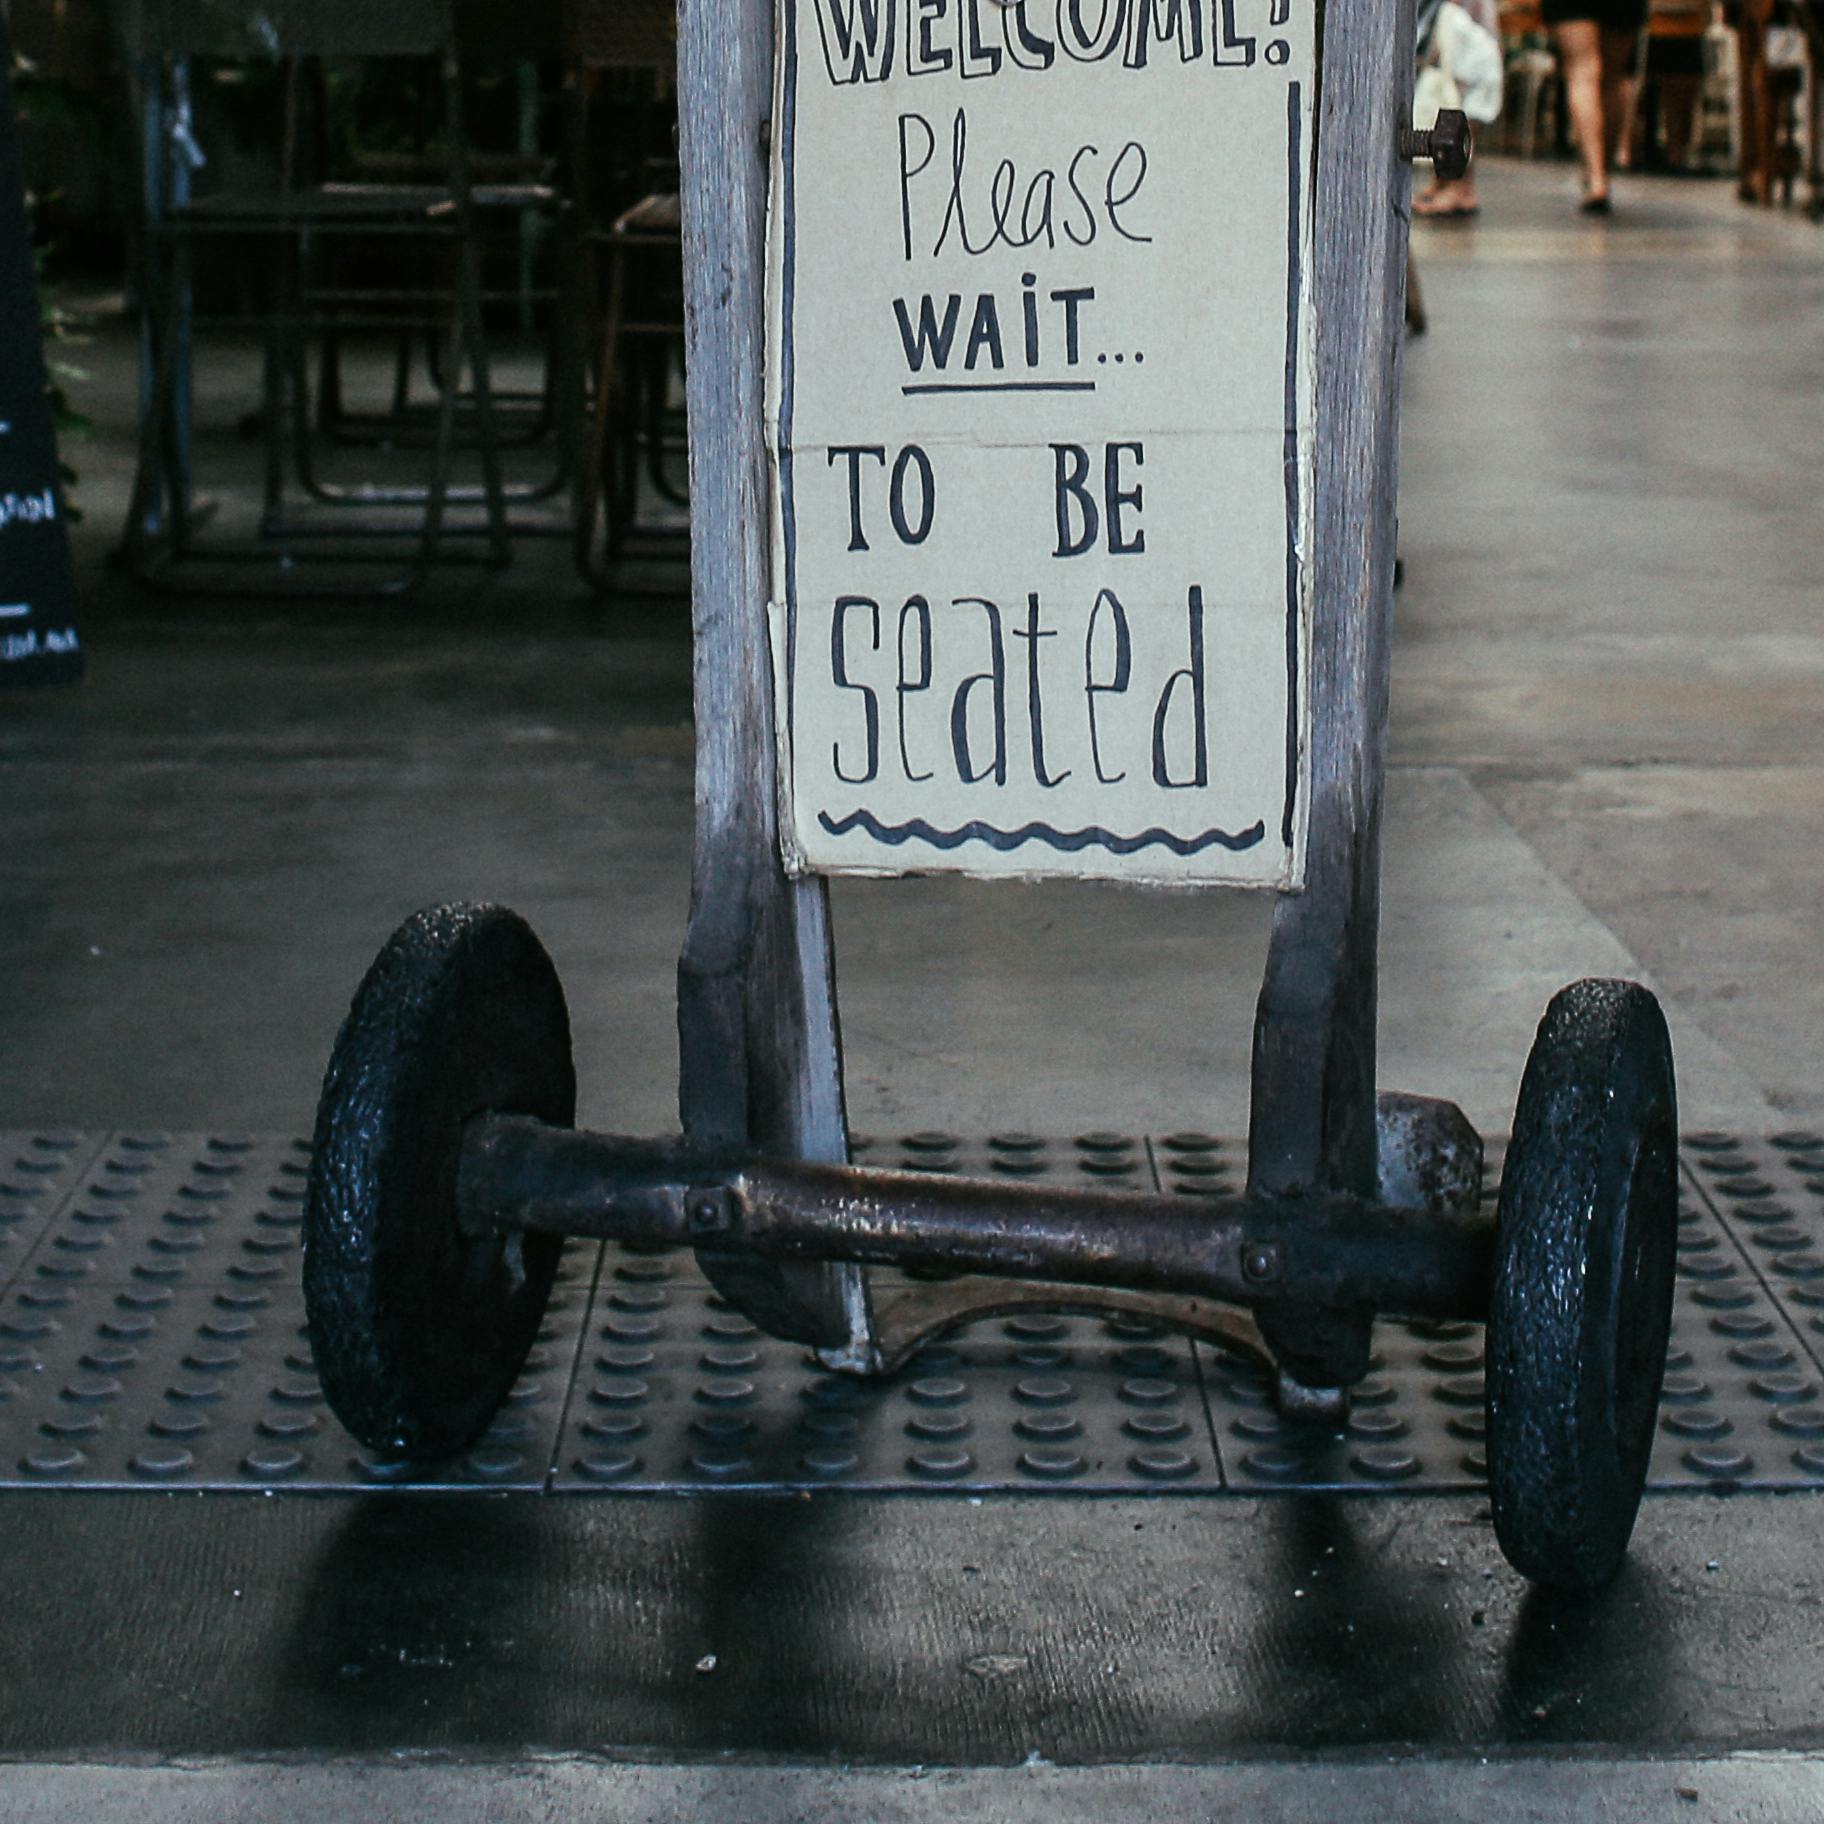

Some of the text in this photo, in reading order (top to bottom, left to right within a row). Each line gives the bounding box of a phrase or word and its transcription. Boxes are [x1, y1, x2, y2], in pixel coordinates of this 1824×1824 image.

[897, 107, 1153, 262] Please
[826, 441, 1146, 559] TO BE
